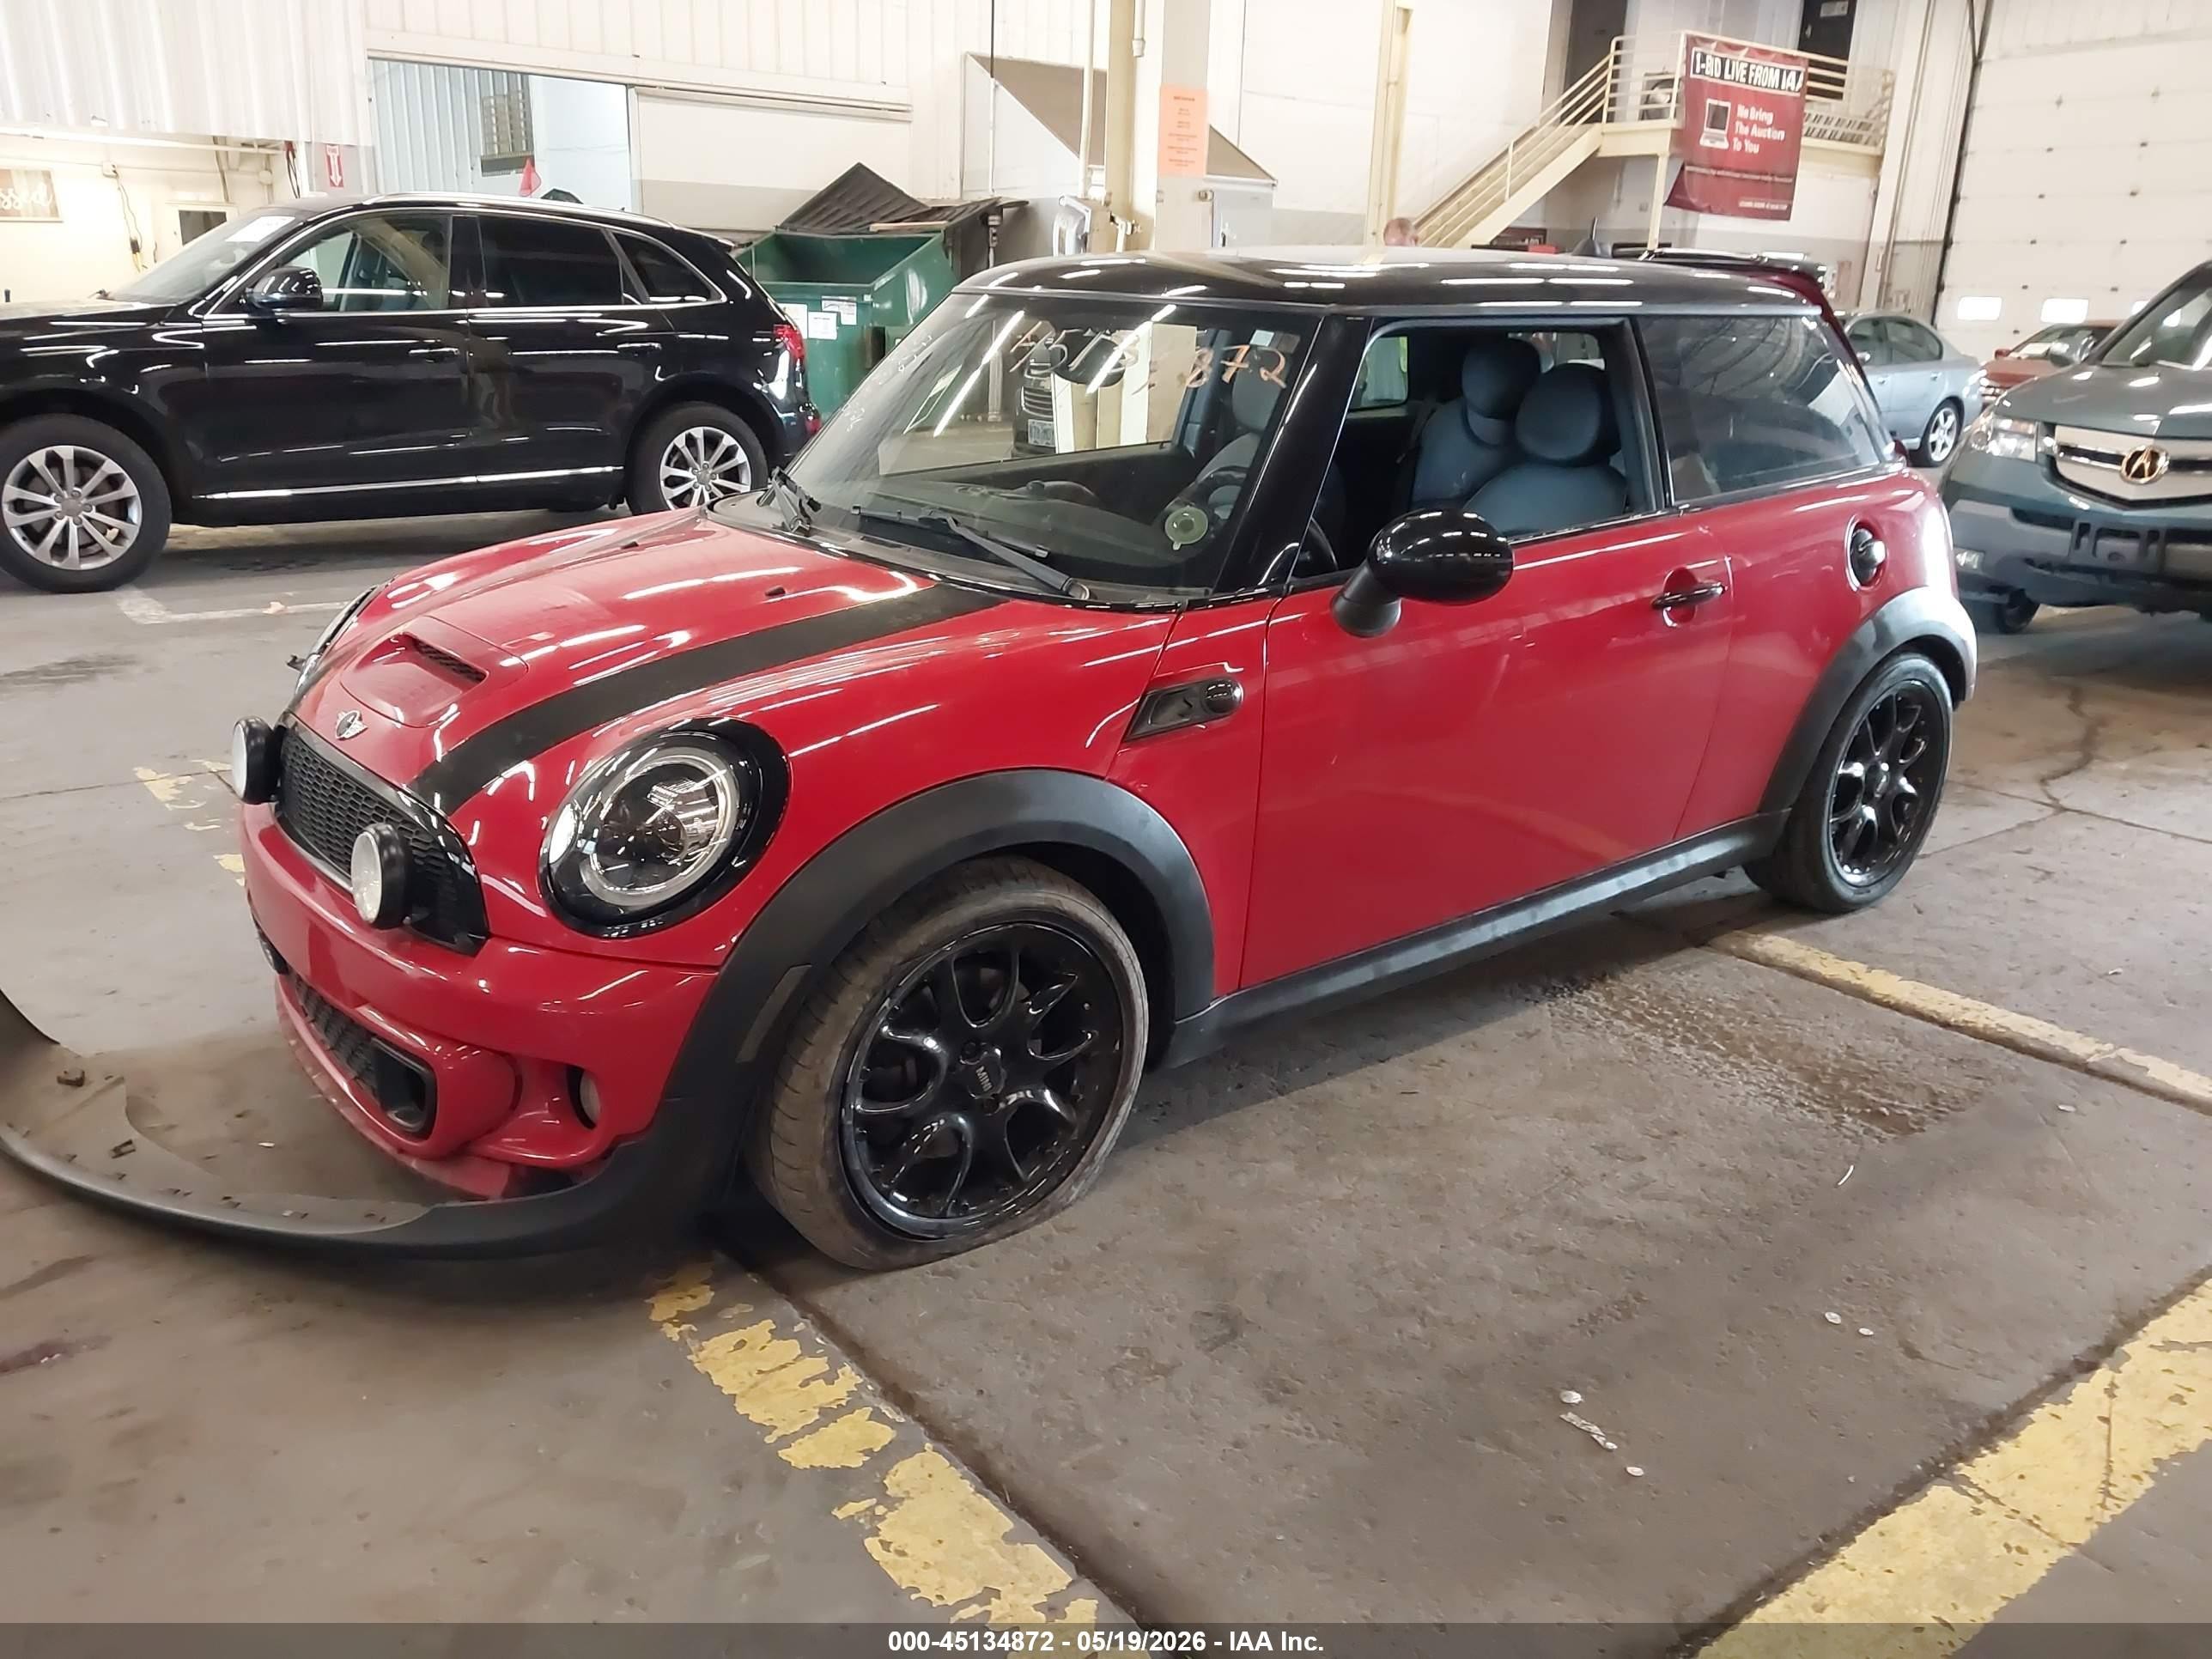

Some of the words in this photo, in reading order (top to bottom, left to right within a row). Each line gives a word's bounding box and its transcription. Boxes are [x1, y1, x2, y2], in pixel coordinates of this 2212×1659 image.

[1723, 58, 1747, 83] LIVE
[1748, 64, 1780, 89] FROM
[1749, 106, 1774, 125] Bring
[1735, 120, 1750, 136] The
[1733, 137, 1742, 152] To
[1744, 138, 1760, 155] You
